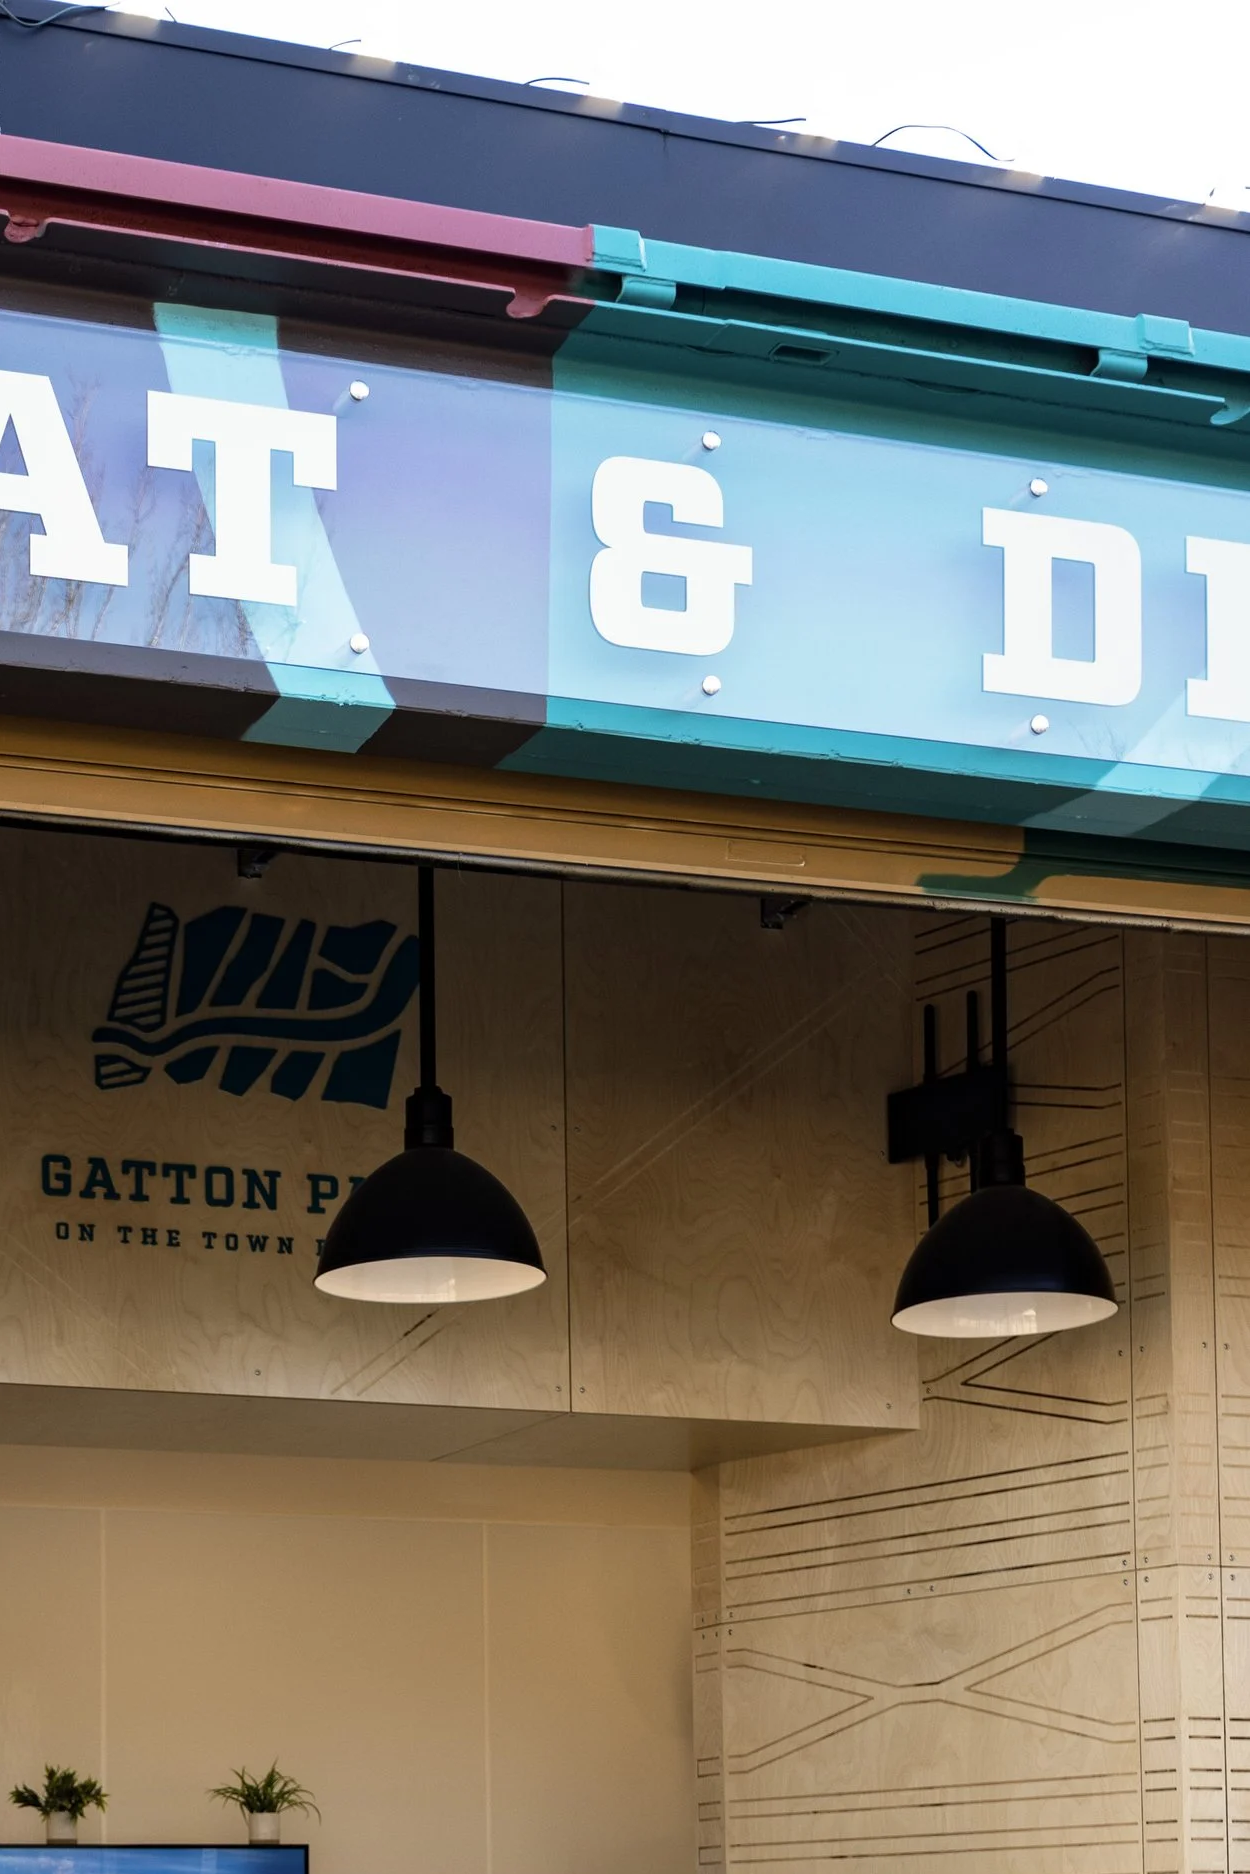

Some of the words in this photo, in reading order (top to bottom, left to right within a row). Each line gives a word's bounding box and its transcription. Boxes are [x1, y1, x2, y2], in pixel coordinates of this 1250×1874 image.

[591, 457, 753, 656] &
[41, 1154, 282, 1211] GATTON
[56, 1222, 96, 1242] ON
[117, 1226, 181, 1248] THE
[202, 1231, 294, 1255] TOWN
